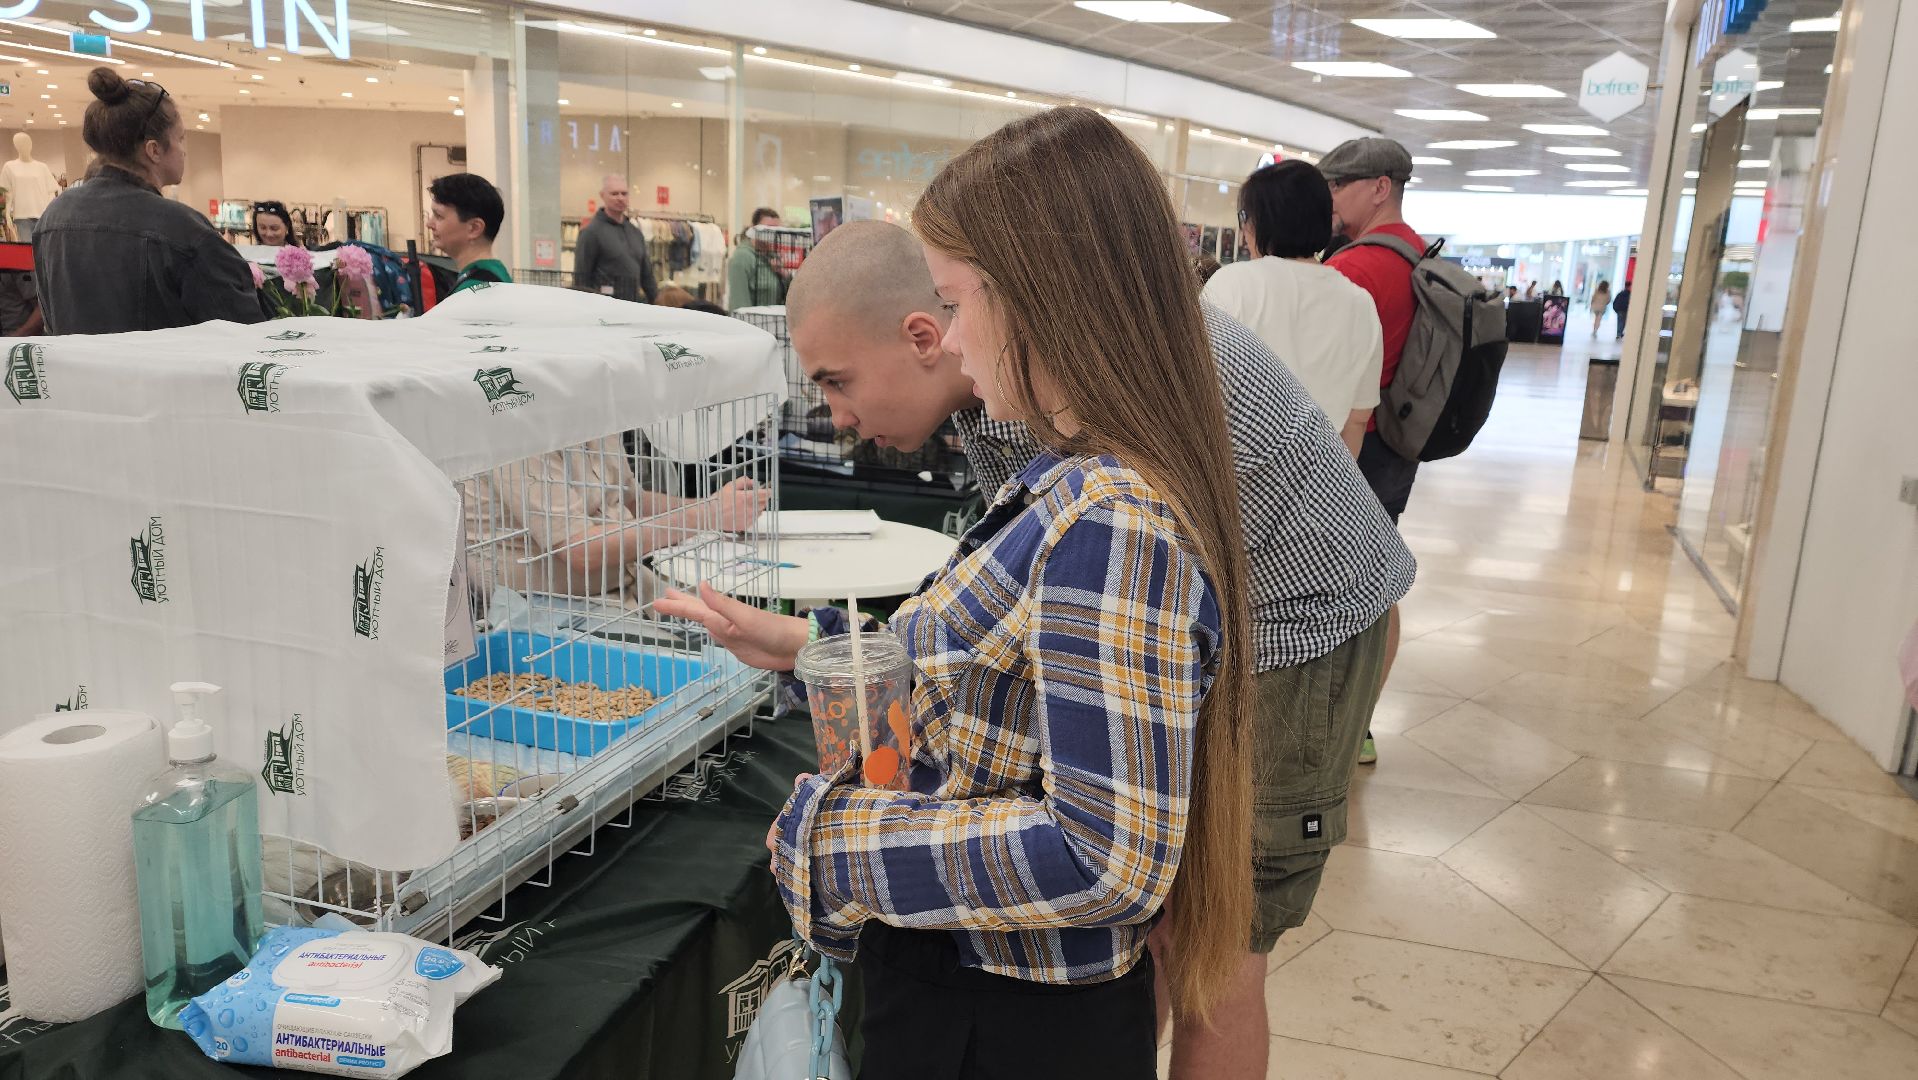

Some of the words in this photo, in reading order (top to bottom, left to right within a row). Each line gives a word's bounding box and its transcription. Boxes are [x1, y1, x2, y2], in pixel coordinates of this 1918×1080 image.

[1586, 78, 1639, 97] befree
[150, 516, 166, 546] ДОМ
[152, 549, 169, 604] УЮТНЫЙ
[374, 546, 385, 579] ДОМ
[370, 581, 382, 640] УЮТНЫЙ
[293, 712, 305, 742] ДОМ
[293, 743, 307, 796] УЮТНЫЙ
[298, 951, 387, 961] АНТИБАКТЕРИАЛЬНЫЕ
[306, 961, 364, 969] antibacterial
[275, 1032, 386, 1057] АНТИБАКТЕРИАЛЬНЫЕ
[275, 1048, 331, 1062] antibacterial
